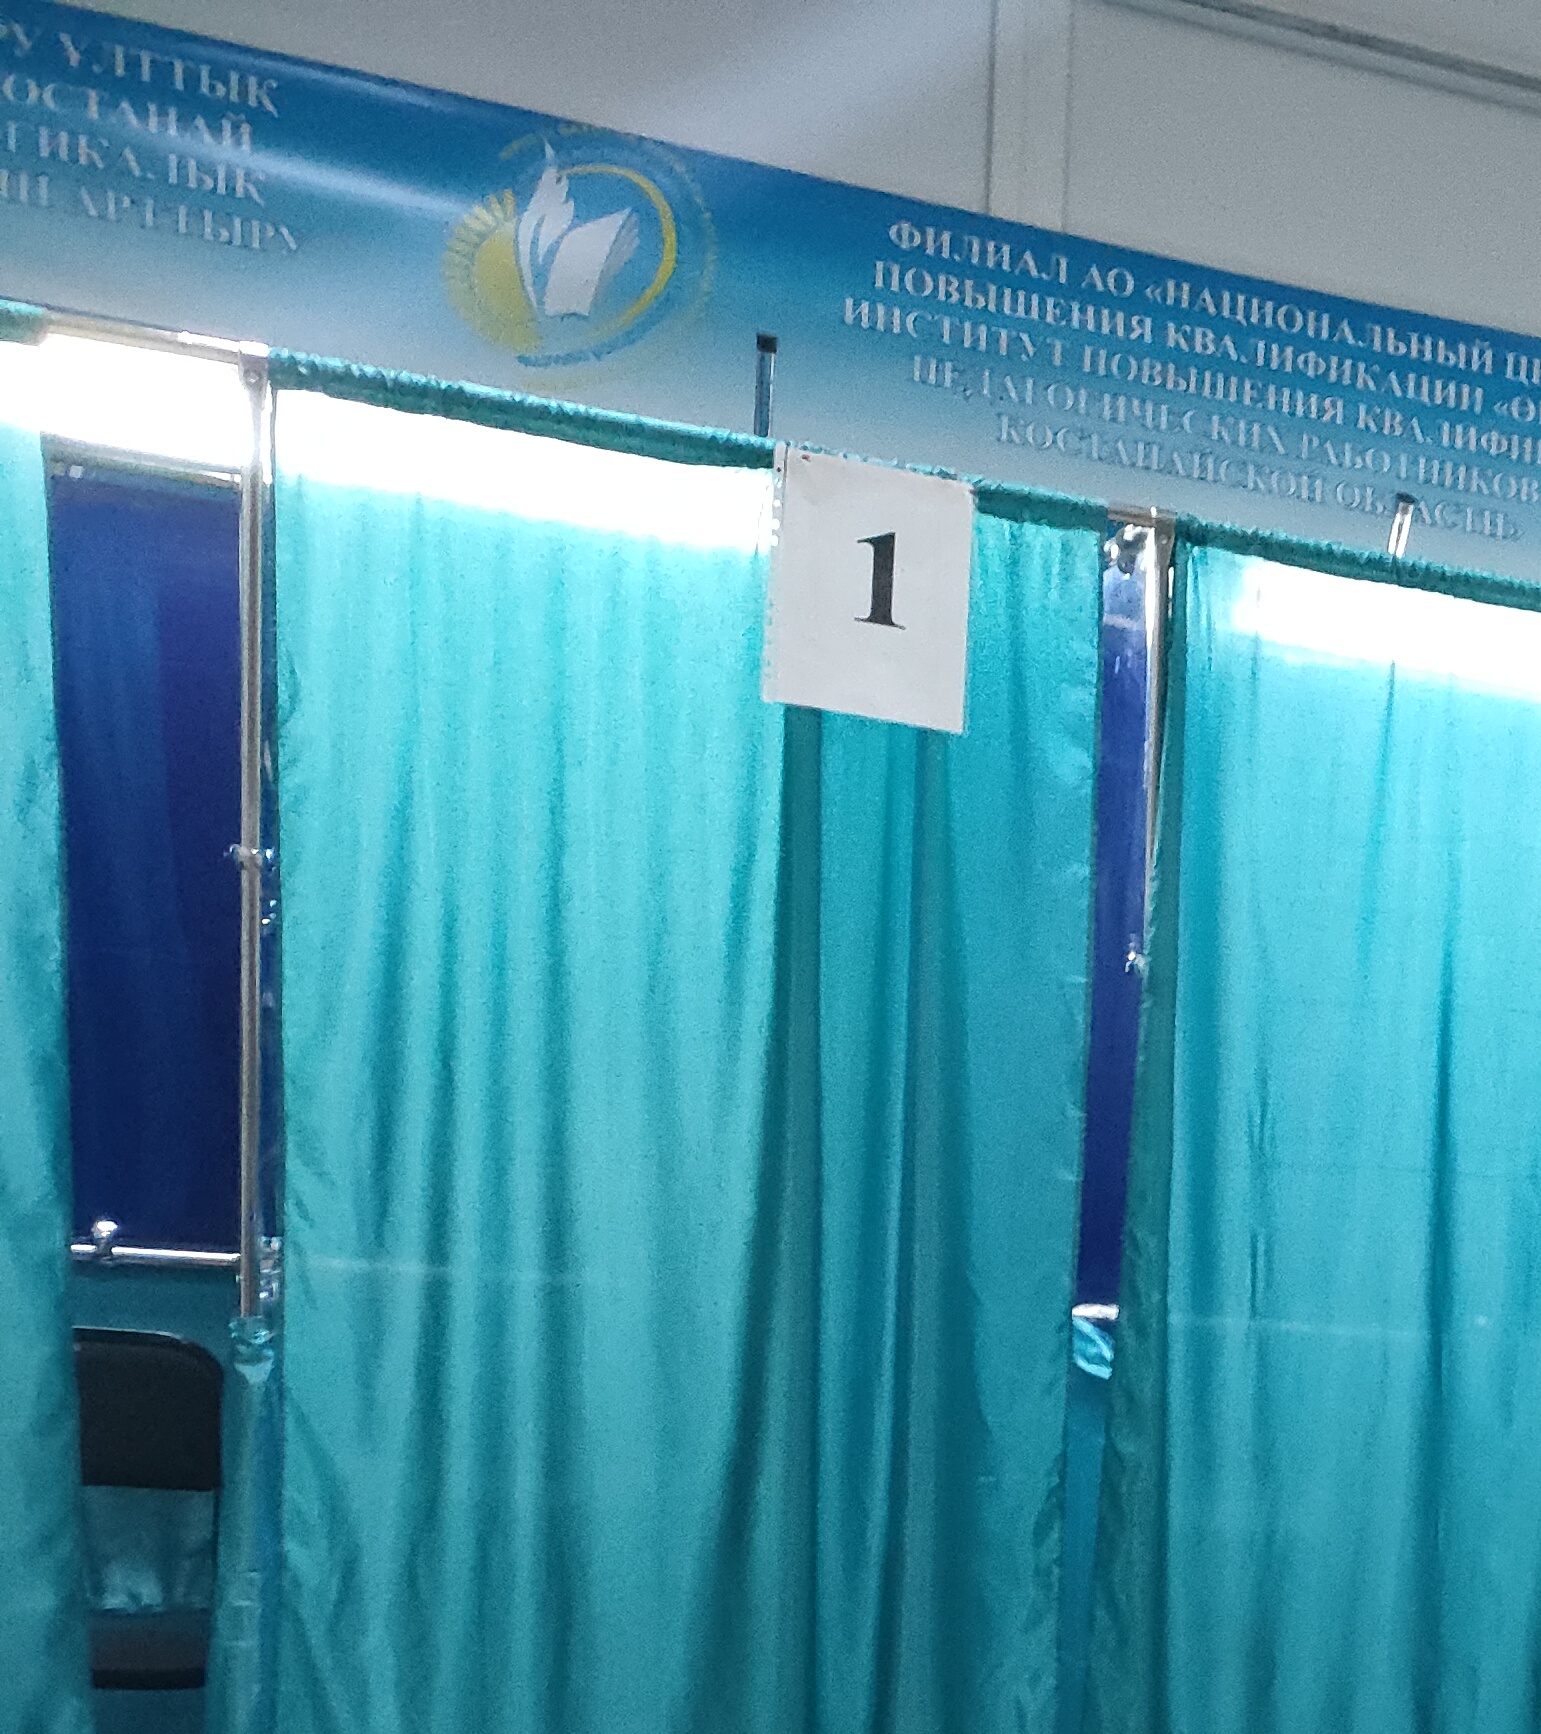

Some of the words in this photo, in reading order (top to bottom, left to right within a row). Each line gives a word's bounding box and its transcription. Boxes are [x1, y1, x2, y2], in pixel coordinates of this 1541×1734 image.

[844, 297, 1066, 366] ИНСТИТУТ
[1083, 344, 1344, 426] ПОВЫШЕНИЯ
[874, 261, 1152, 344] ПОВЫШЕНИЯ
[1166, 321, 1484, 415] КВАЛИФИКАЦИИ
[888, 221, 1068, 285] ФИЛИАЛ
[1081, 263, 1136, 298] АО
[1145, 277, 1494, 375] «НАЦИОНАЛЬНЫЙ
[913, 355, 1288, 454] ПЕДАГОГИЧЕСКИХ
[1301, 432, 1540, 502] РАБОТНИКОВ
[854, 531, 907, 631] 1
